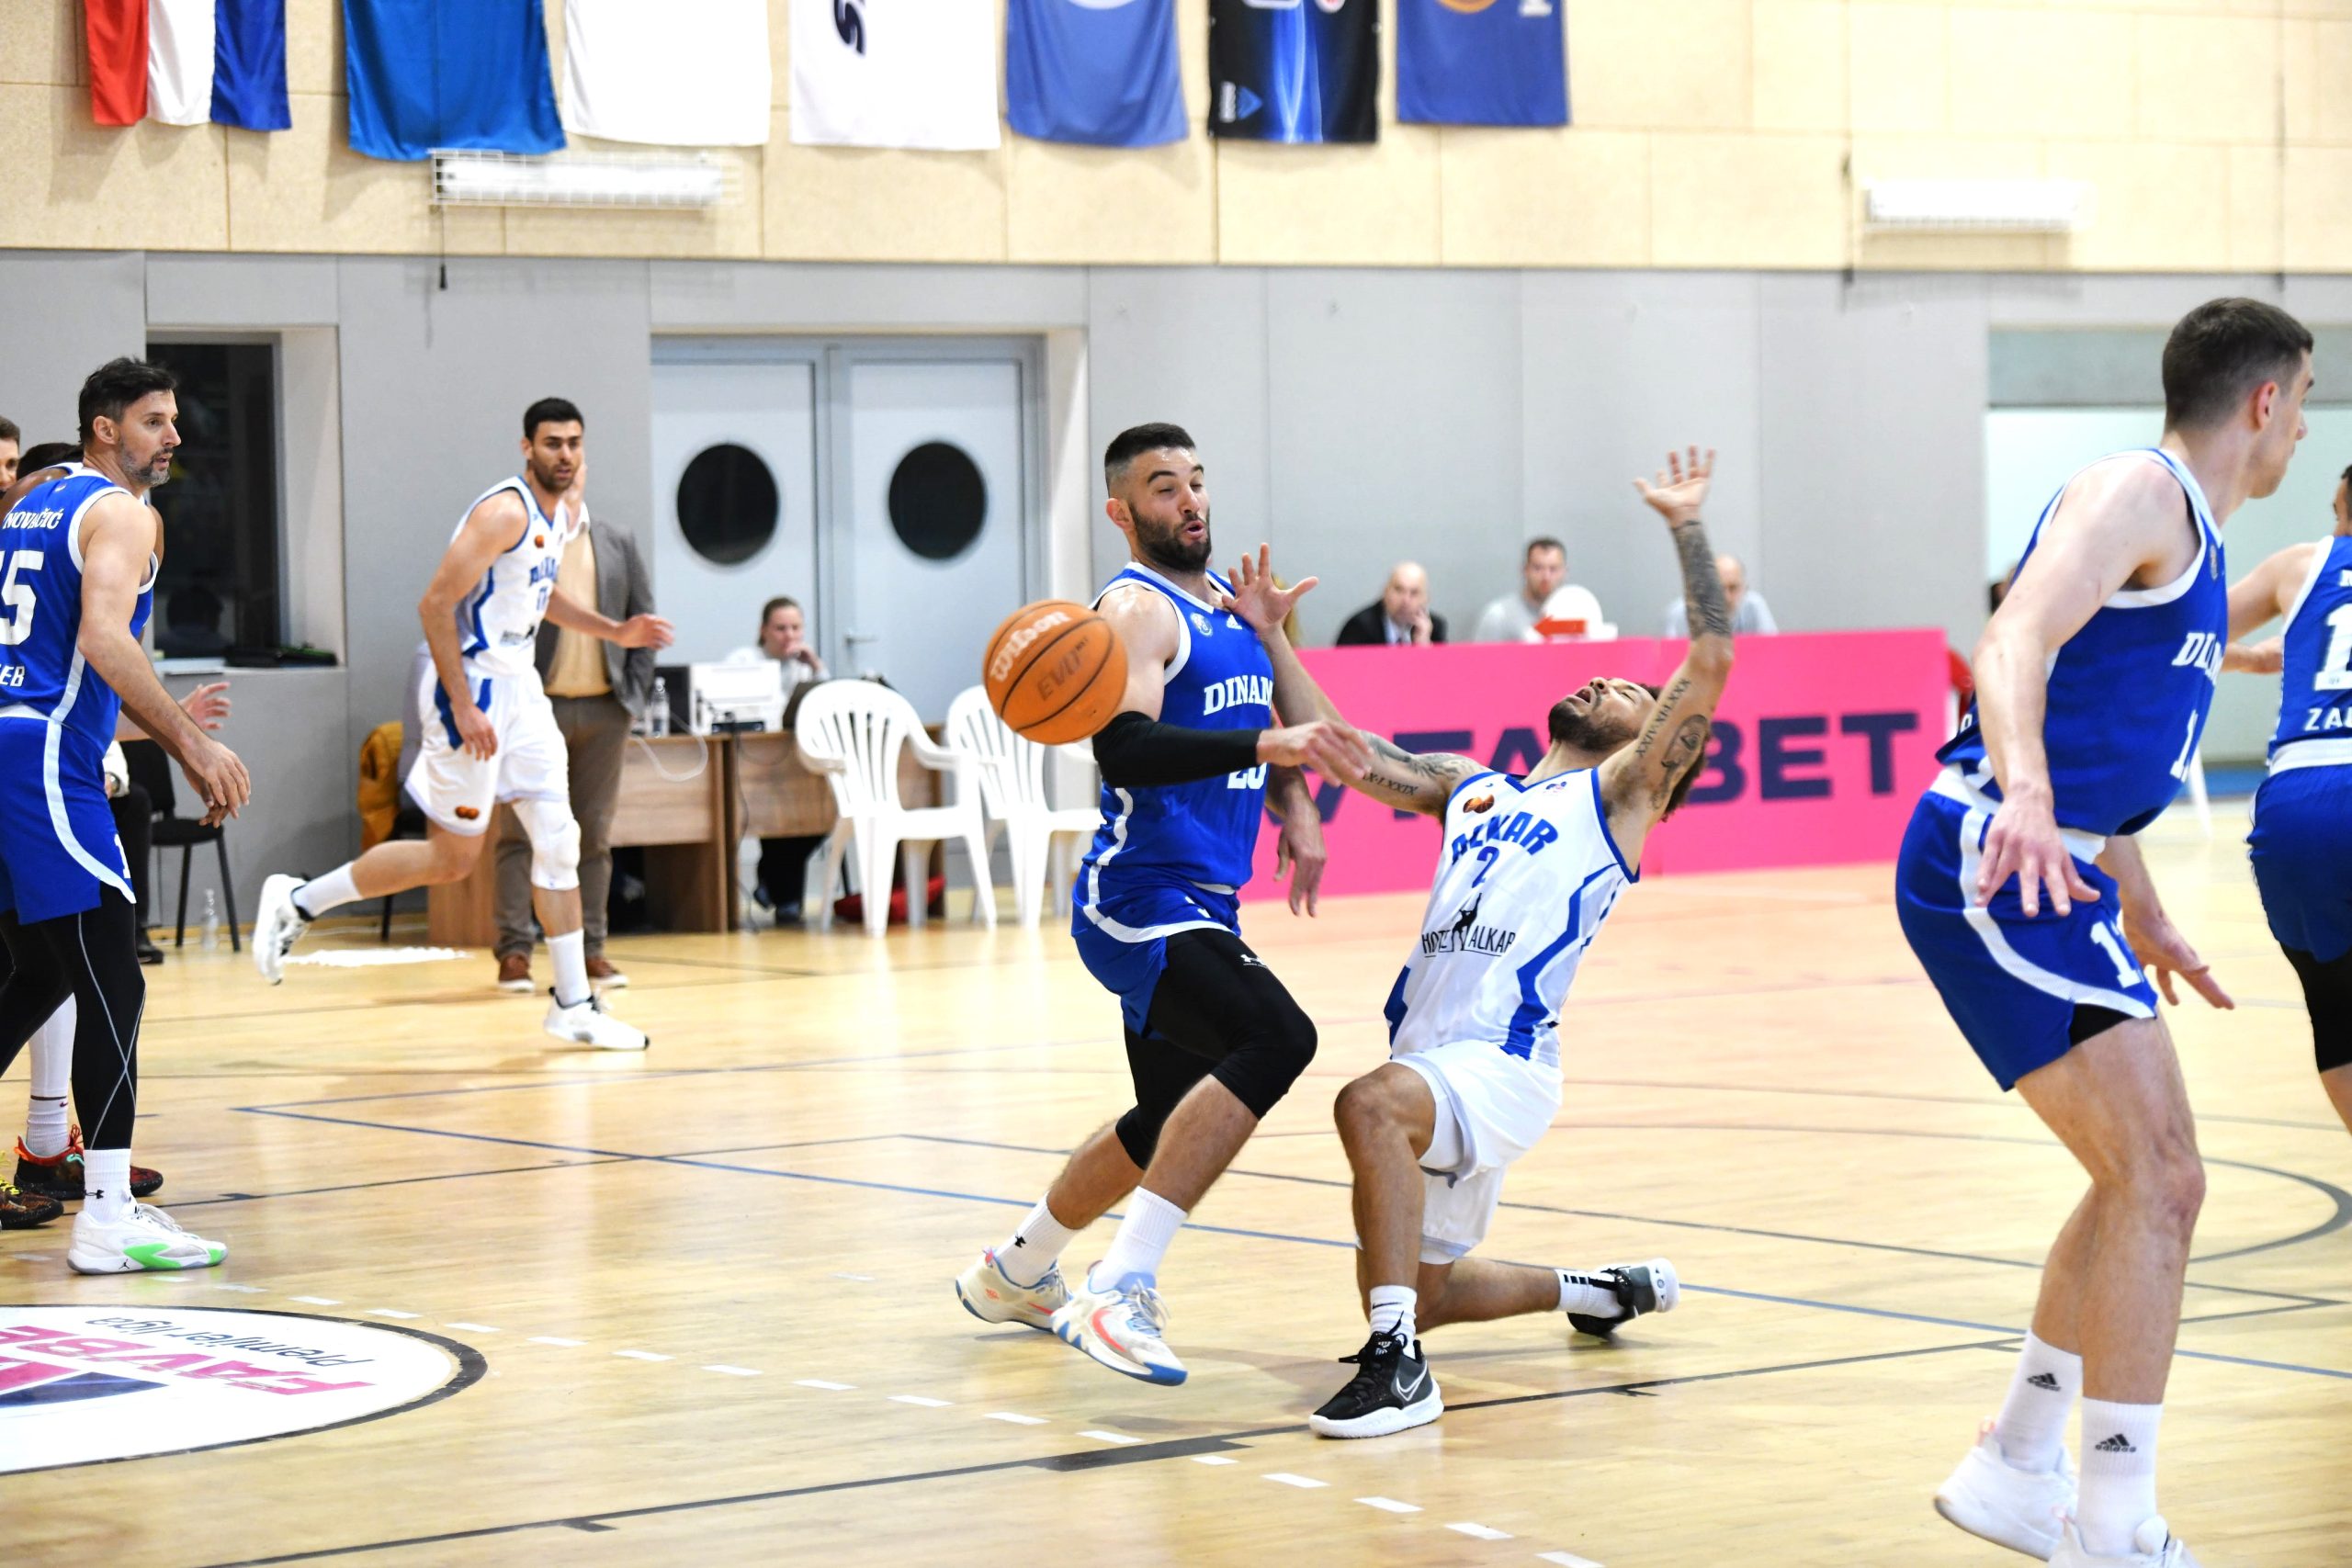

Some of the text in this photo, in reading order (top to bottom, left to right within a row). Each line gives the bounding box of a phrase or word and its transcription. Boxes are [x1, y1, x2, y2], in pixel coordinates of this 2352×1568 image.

[3, 508, 65, 530] NOVAČIĆ
[990, 611, 1074, 682] Wilson
[1036, 650, 1082, 701] EVO
[1452, 811, 1559, 865] ALKAR
[1471, 846, 1500, 889] 2
[1468, 925, 1517, 953] ALKAR
[85, 1317, 185, 1336] liga
